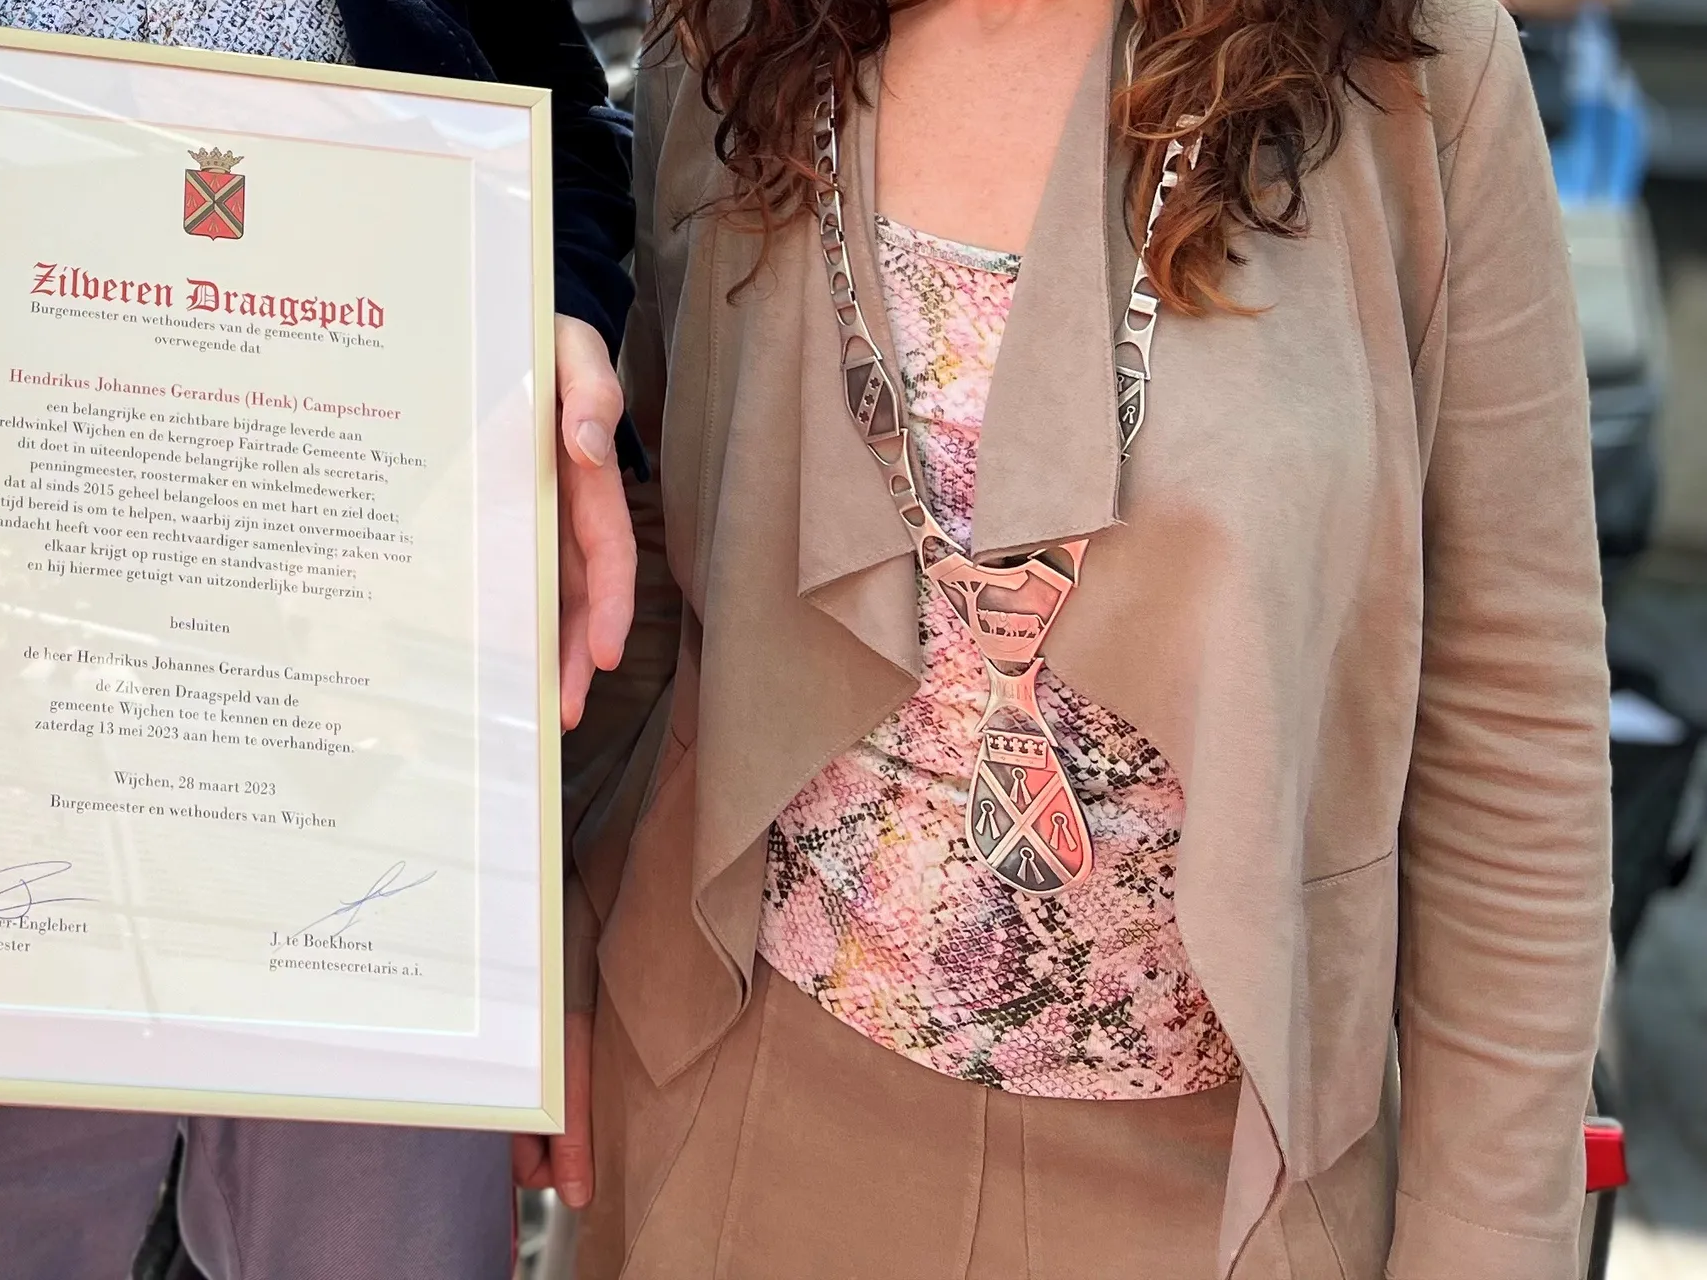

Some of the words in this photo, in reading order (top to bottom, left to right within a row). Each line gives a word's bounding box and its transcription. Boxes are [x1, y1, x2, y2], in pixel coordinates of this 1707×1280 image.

[30, 261, 174, 308] Zilveren
[185, 277, 384, 331] Draagspeld
[30, 300, 120, 321] Burgemeester
[122, 313, 138, 323] en
[141, 314, 216, 333] wethouders
[218, 323, 243, 334] van
[245, 322, 262, 336] de
[264, 328, 324, 342] gemeente
[154, 335, 237, 352] overwegende
[239, 339, 260, 355] dat
[9, 368, 91, 390] Hendrikus
[94, 376, 167, 397] Johannes
[170, 383, 241, 404] Gerardus
[244, 391, 298, 414] (Henk)
[302, 396, 401, 420] Campschroer
[46, 403, 70, 415] een
[71, 401, 147, 424] belangrijke
[149, 413, 165, 423] en
[168, 411, 230, 430] zichtbare
[232, 416, 287, 438] bijdrage
[290, 422, 336, 440] leverde
[338, 431, 363, 442] aan
[71, 420, 127, 440] Wijchen
[128, 430, 145, 441] en
[147, 427, 165, 442] de
[167, 429, 235, 453] kerngroep
[238, 436, 299, 455] Fairtrade
[302, 442, 367, 462] Gemeente
[17, 435, 37, 450] dit
[39, 437, 70, 453] doet
[72, 441, 86, 455] in
[89, 443, 183, 466] uiteenlopende
[184, 450, 259, 474] belangrijke
[261, 458, 299, 475] rollen
[302, 462, 321, 477] als
[3, 474, 27, 490] dat
[29, 476, 43, 491] al
[45, 478, 80, 494] sinds
[83, 480, 115, 497] 2015
[117, 485, 160, 502] geheel
[163, 488, 240, 510] belangeloos
[242, 499, 258, 510] en
[261, 501, 287, 513] met
[290, 499, 319, 516] hart
[322, 506, 338, 518] en
[341, 505, 364, 520] ziel
[140, 470, 230, 488] roostermaker
[231, 478, 248, 490] en
[27, 495, 70, 513] bereid
[72, 500, 84, 514] is
[86, 505, 108, 516] om
[111, 505, 126, 518] te
[180, 511, 231, 531] waarbij
[233, 515, 260, 533] zijn
[262, 517, 296, 534] inzet
[298, 524, 397, 543] onvermoeibaar
[44, 537, 87, 558] elkaar
[89, 541, 128, 563] krijgt
[131, 549, 149, 565] op
[151, 550, 199, 568] rustige
[201, 556, 218, 567] en
[220, 555, 304, 577] standvastige
[54, 518, 90, 535] heeft
[92, 526, 124, 538] voor
[125, 529, 149, 540] een
[152, 528, 250, 552] rechtvaardiger
[341, 545, 379, 560] zaken
[382, 552, 413, 563] voor
[27, 561, 43, 571] en
[47, 557, 66, 577] hij
[69, 560, 124, 578] hiermee
[126, 567, 176, 586] getuigt
[177, 573, 203, 585] van
[206, 572, 299, 596] uitzonderlijke
[301, 580, 364, 600] burgerzin
[169, 615, 230, 634] besluiten
[23, 645, 40, 660] de
[43, 646, 73, 662] heer
[76, 649, 149, 669] Hendrikus
[151, 655, 216, 674] Johannes
[218, 661, 281, 680] Gerardus
[283, 666, 370, 687] Campschroer
[95, 678, 111, 693] de
[114, 680, 171, 698] Zilveren
[174, 684, 255, 707] Draagspeld
[254, 695, 281, 707] van
[283, 692, 299, 708] de
[34, 718, 96, 738] zaterdag
[99, 720, 115, 735] 13
[117, 724, 143, 737] mei
[146, 724, 180, 740] 2023
[182, 730, 208, 742] aan
[211, 728, 241, 745] hem
[244, 734, 258, 746] te
[261, 734, 354, 756] overhandigen.
[49, 699, 115, 718] gemeente
[118, 700, 175, 721] Wijchen
[178, 707, 200, 721] toe
[203, 710, 217, 722] te
[220, 708, 270, 729] kennen
[272, 717, 289, 729] en
[291, 714, 322, 737] deze
[324, 721, 342, 737] op
[178, 775, 195, 791] 28
[198, 781, 240, 794] maart
[243, 780, 276, 796] 2023
[50, 794, 146, 814] Burgemeester
[148, 804, 165, 816] en
[168, 803, 248, 822] wethouders
[251, 812, 277, 824] van
[280, 810, 336, 830] Wijchen
[303, 933, 373, 952] Boekhorst
[269, 957, 398, 975] gemeentesecretaris
